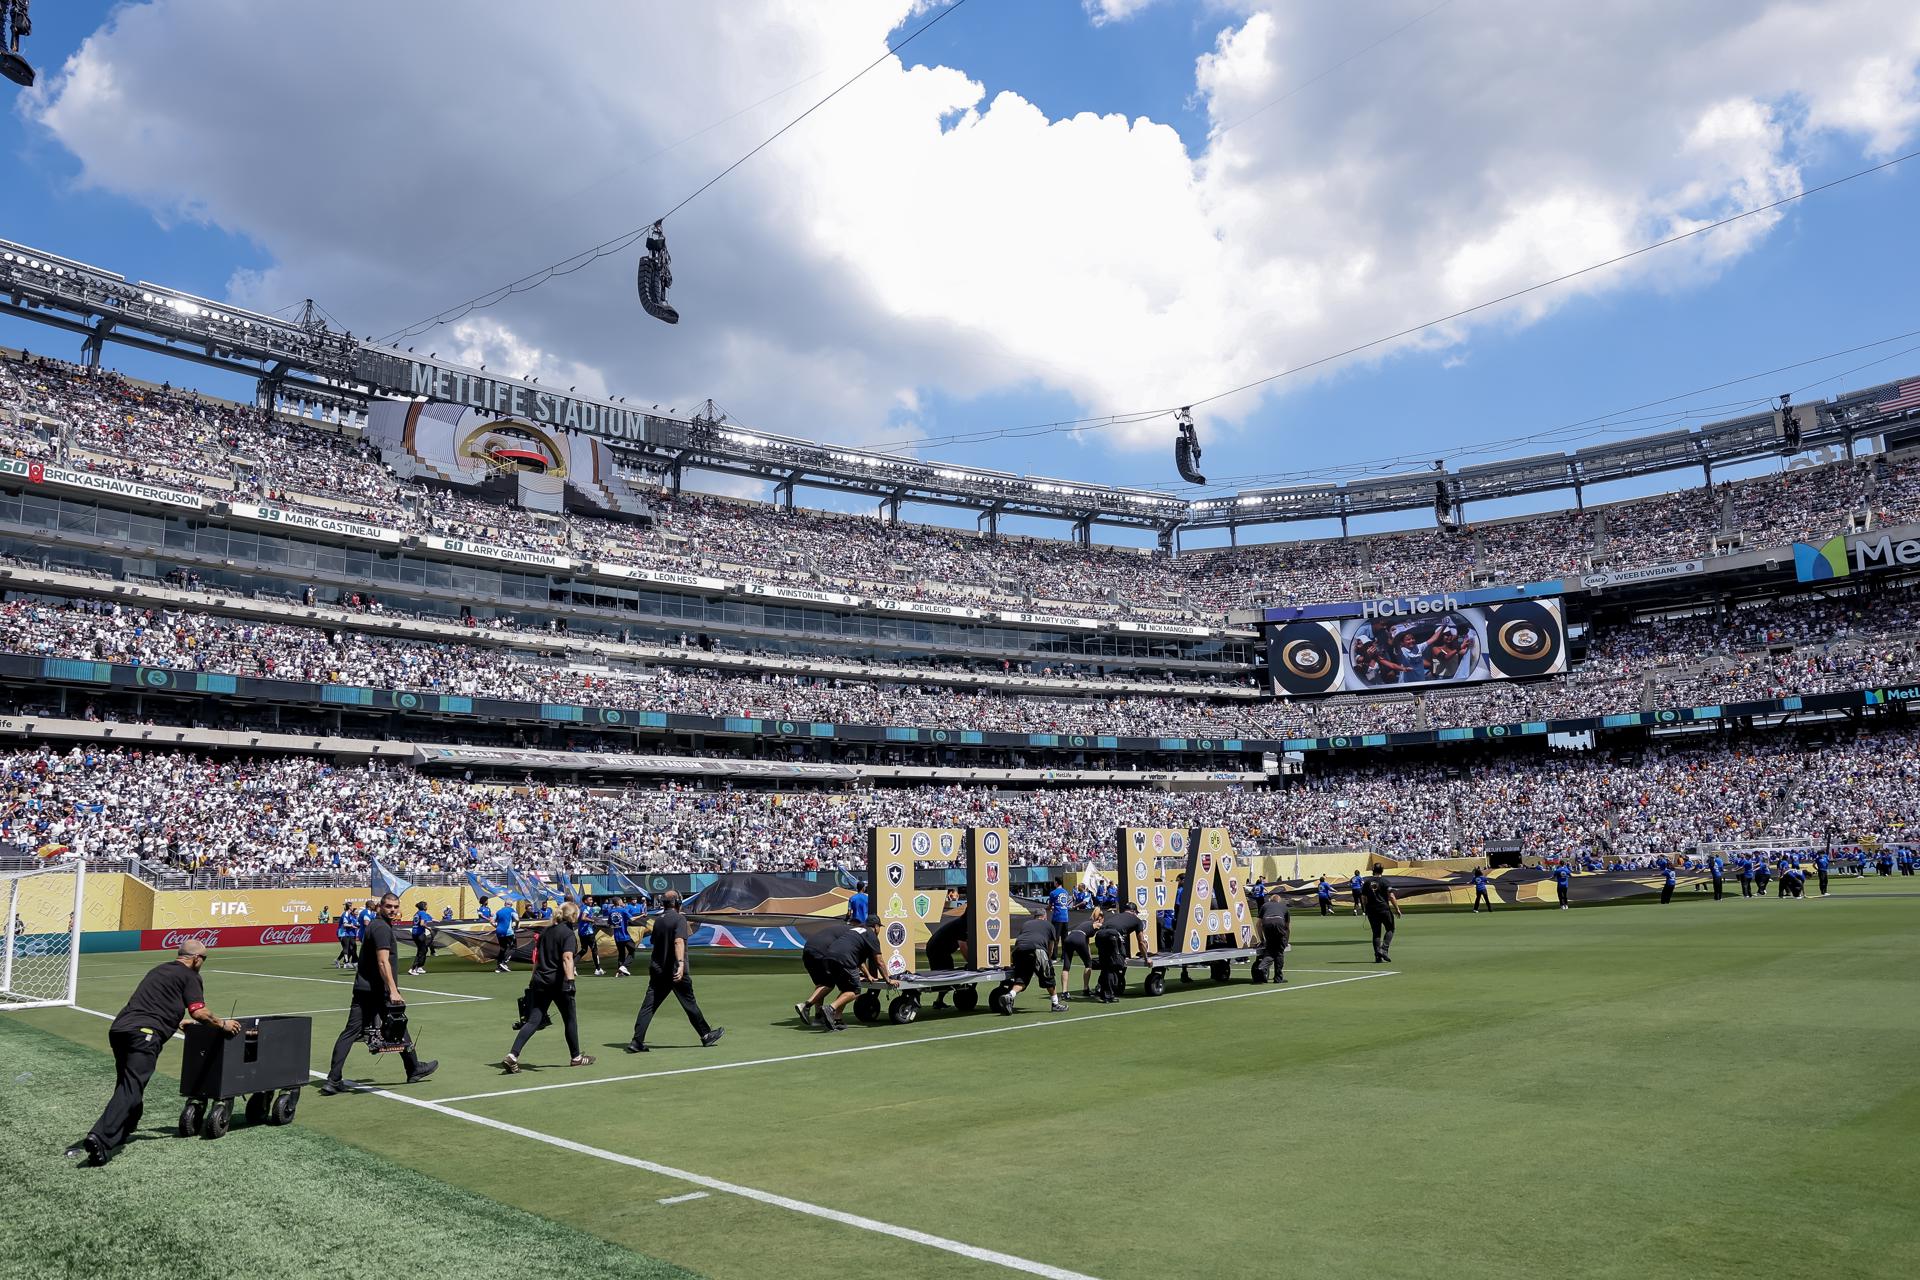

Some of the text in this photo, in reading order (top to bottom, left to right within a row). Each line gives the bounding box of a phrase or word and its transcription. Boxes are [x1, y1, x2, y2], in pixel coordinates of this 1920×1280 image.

[411, 362, 645, 441] METLIFE STADIUM
[0, 458, 27, 475] 60
[135, 486, 200, 506] FERGUSON
[257, 507, 381, 538] 99 MARK GASTINEAU
[444, 540, 555, 565] 60 LARRY GRANTHAM
[625, 570, 698, 585] JETS LEON HESS
[1614, 571, 1639, 581] WEEB
[1640, 566, 1678, 577] EWBANK
[751, 584, 829, 601] 75 WINSTON HILL
[883, 600, 951, 614] 73 JOE KLECKO
[1362, 594, 1458, 619] HCLTech
[1020, 613, 1079, 625] 93 MARTY LYONS
[1136, 623, 1147, 631] 74
[1163, 626, 1193, 634] MANGOLD
[210, 901, 248, 916] FIFA
[281, 905, 313, 913] ULTRA
[260, 925, 316, 945] Coca-Cola
